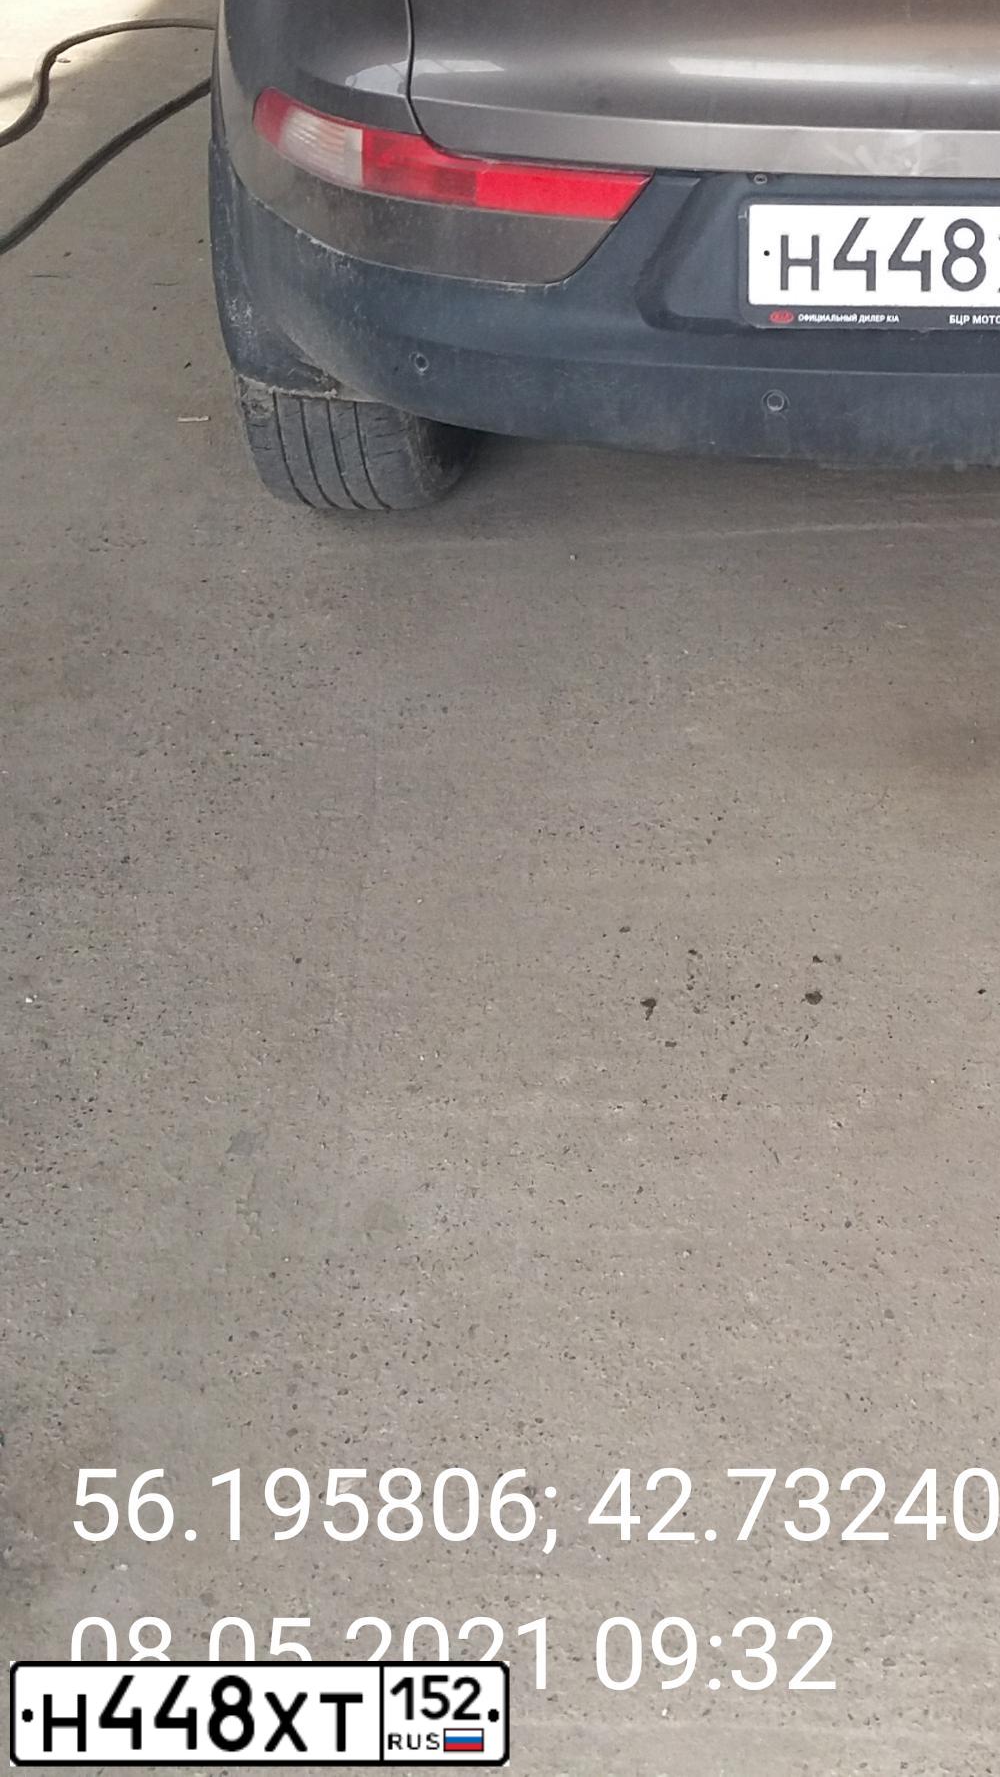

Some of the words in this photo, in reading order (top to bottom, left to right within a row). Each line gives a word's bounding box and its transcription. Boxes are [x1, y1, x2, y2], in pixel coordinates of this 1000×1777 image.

[798, 312, 858, 324] ОФИЦИАЛЬНЫЙ
[858, 314, 886, 325] ДИЛЕР
[949, 313, 970, 326] БЦР
